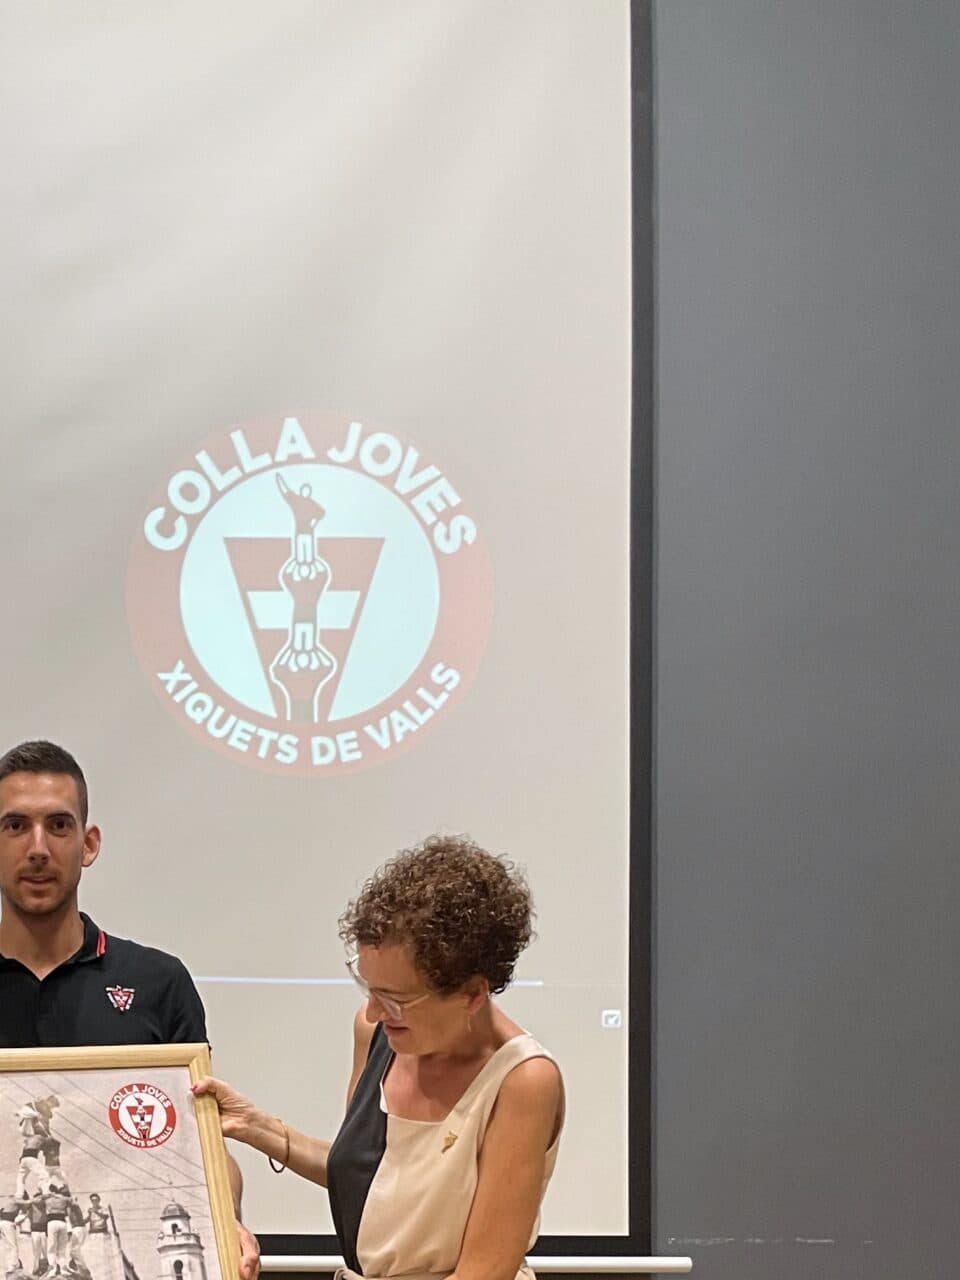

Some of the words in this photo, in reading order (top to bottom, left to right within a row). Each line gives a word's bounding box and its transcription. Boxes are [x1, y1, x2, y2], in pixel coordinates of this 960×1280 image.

[144, 417, 315, 551] COLLA
[327, 422, 476, 554] JOVES
[157, 660, 299, 764] XIQUETS
[311, 731, 362, 765] DE
[363, 661, 460, 749] VALLS
[110, 1084, 139, 1110] COLLA
[142, 1085, 171, 1108] JOVES
